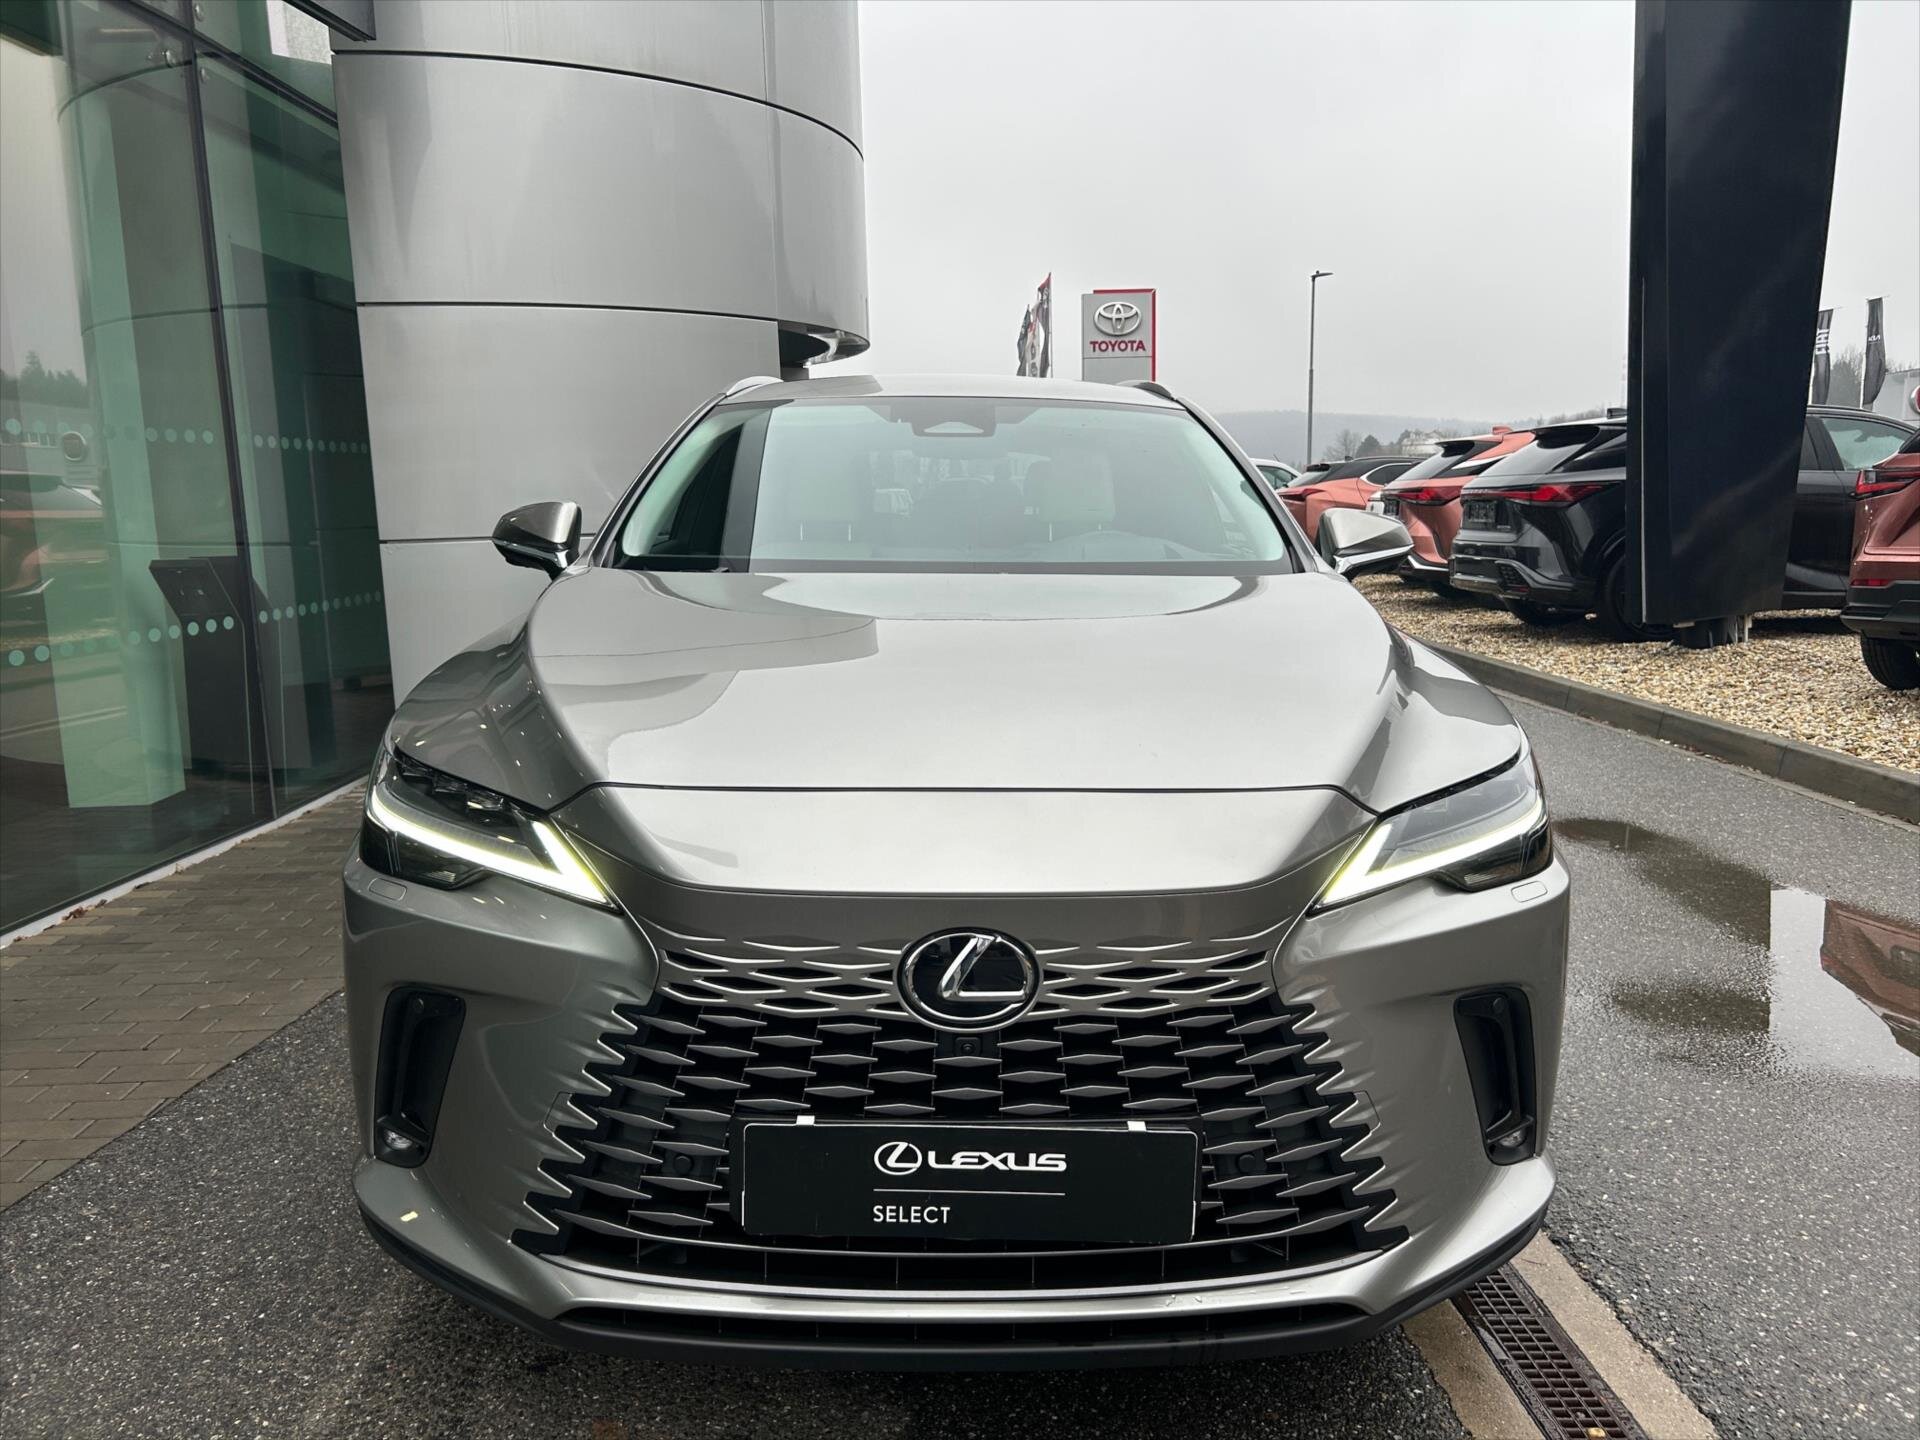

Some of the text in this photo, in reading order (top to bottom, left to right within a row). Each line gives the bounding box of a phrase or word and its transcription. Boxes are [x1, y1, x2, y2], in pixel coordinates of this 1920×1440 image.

[1090, 340, 1146, 352] TOYOTA
[1815, 328, 1830, 355] FIAT
[928, 1151, 1067, 1172] LEXUS
[873, 1205, 951, 1224] SELECT
